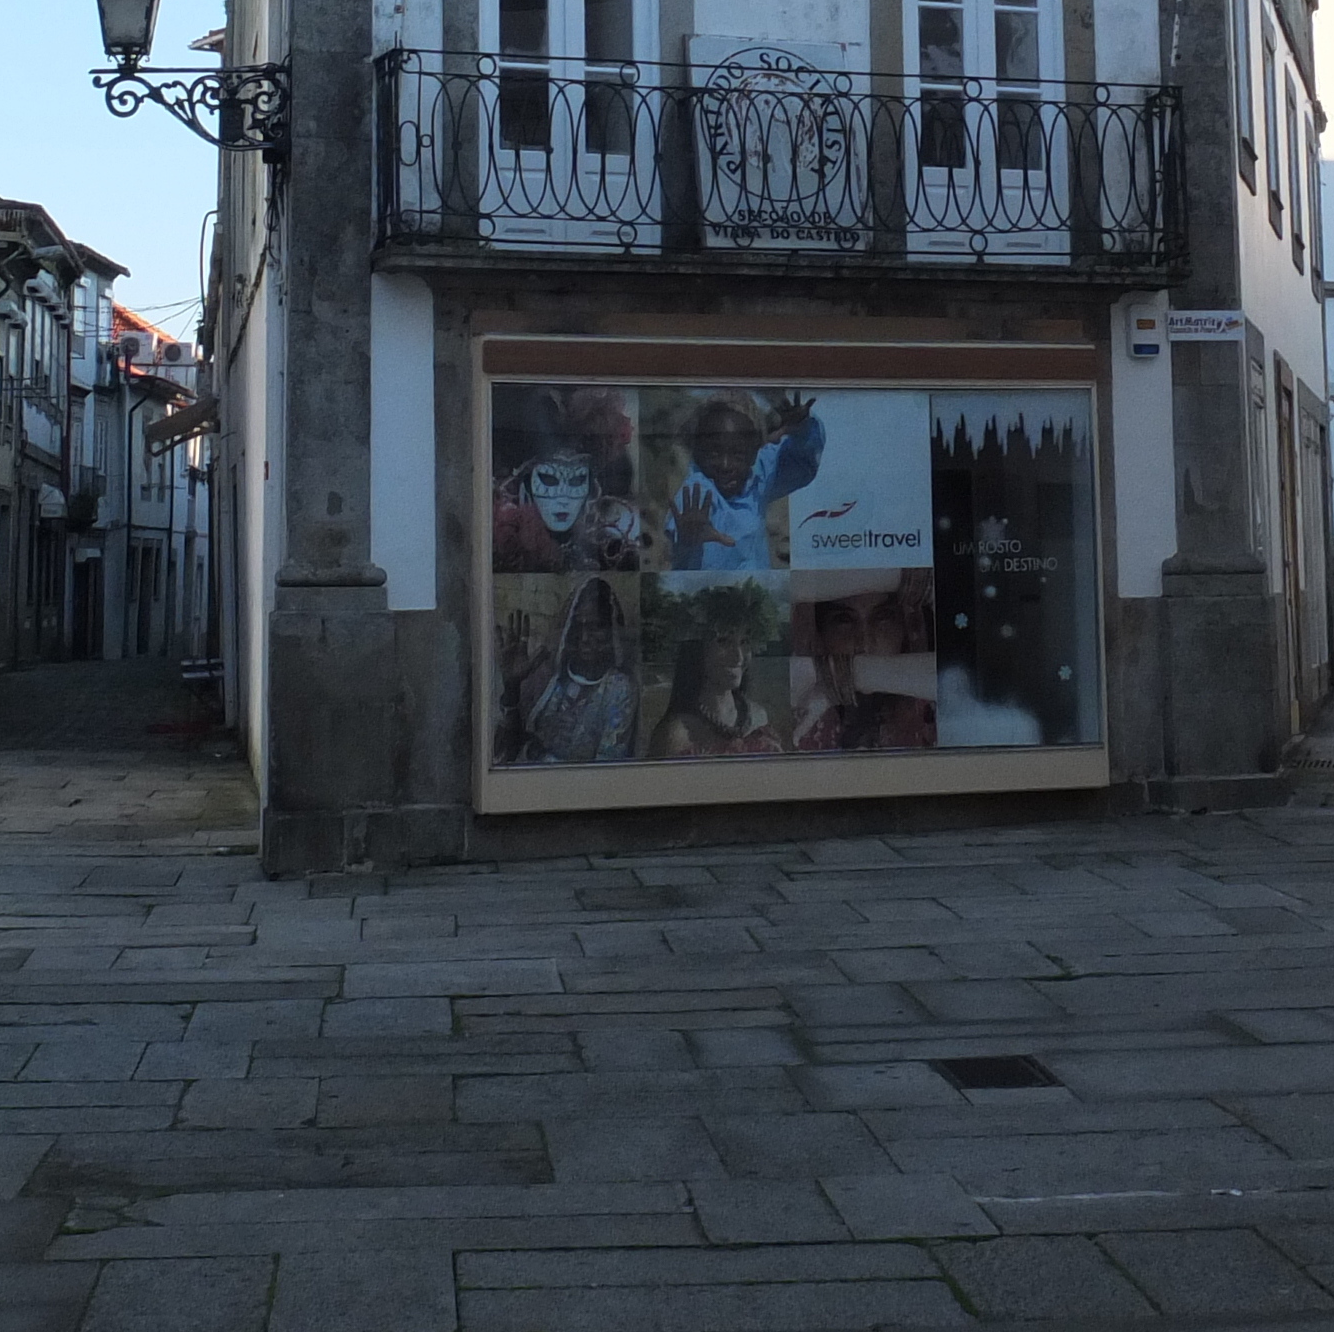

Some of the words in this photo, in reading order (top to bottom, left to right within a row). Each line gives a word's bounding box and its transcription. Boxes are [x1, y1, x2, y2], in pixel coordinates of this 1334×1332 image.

[770, 227, 791, 240] DO
[811, 529, 921, 549] sweettravel
[978, 540, 1022, 555] ROSTO
[1003, 557, 1058, 573] DESTINO
